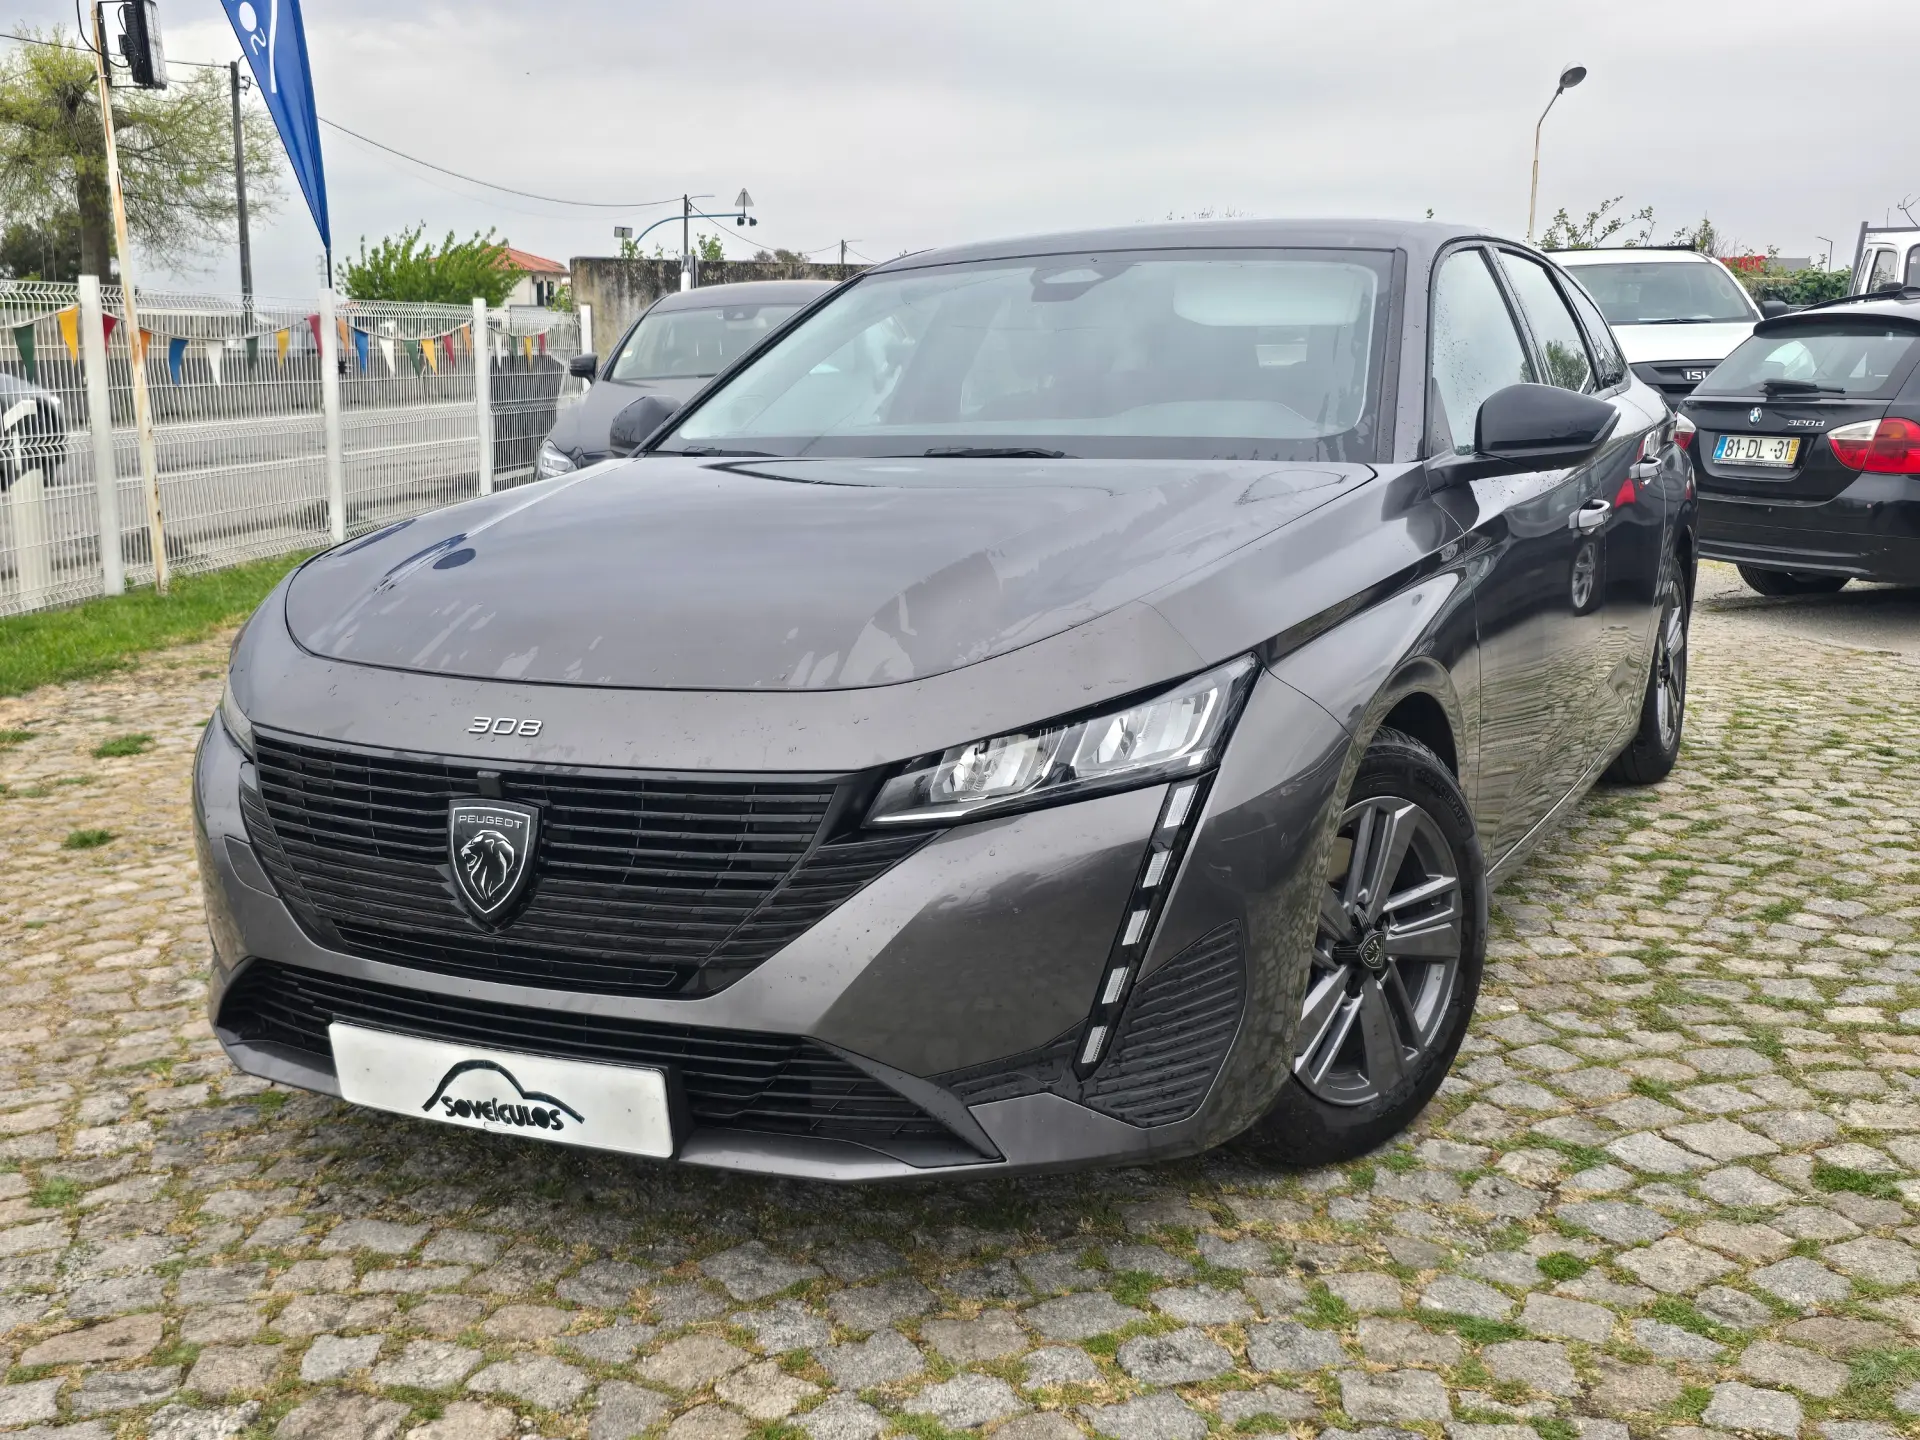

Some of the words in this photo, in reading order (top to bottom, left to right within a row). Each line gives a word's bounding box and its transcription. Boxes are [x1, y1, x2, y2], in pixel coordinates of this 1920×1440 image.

[1787, 419, 1825, 427] 320d
[468, 716, 544, 736] 308
[459, 814, 523, 829] PEUGEOT
